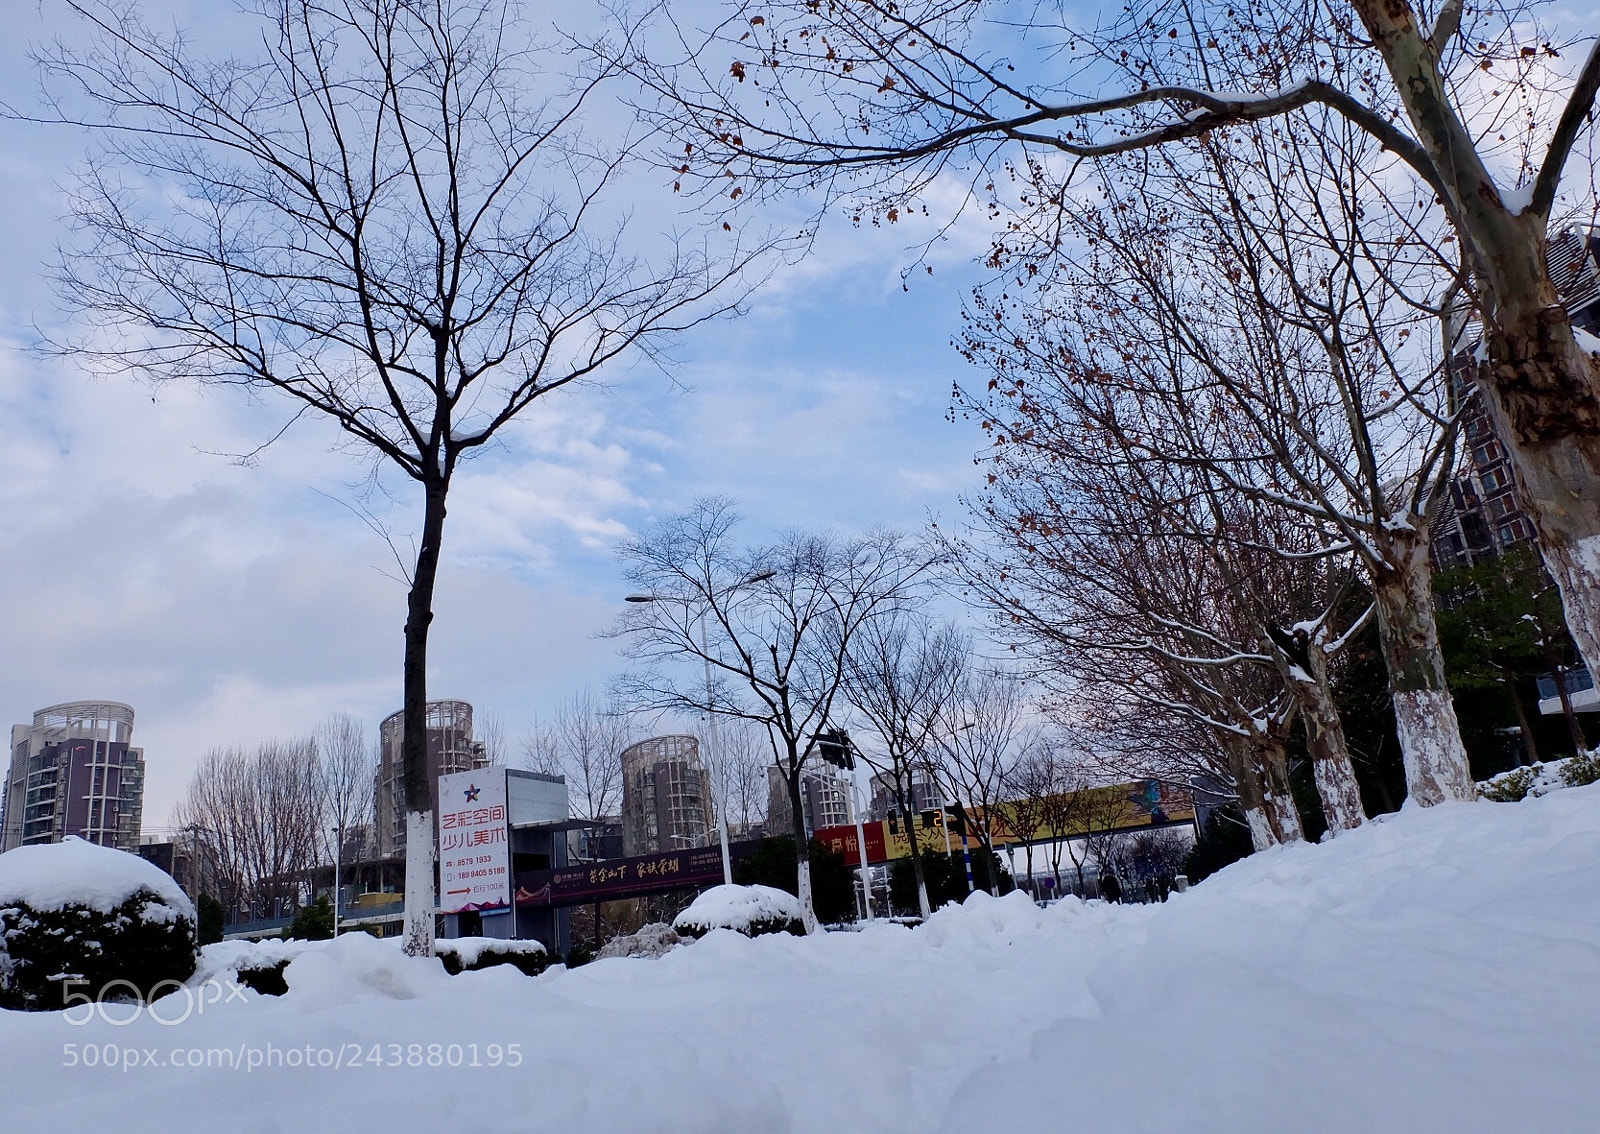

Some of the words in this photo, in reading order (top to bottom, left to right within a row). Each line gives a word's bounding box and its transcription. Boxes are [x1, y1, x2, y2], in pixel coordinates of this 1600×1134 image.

[442, 804, 505, 830] 艺彩空间
[442, 826, 506, 851] 少儿美术
[457, 857, 474, 867] 8579
[475, 855, 492, 864] 1933
